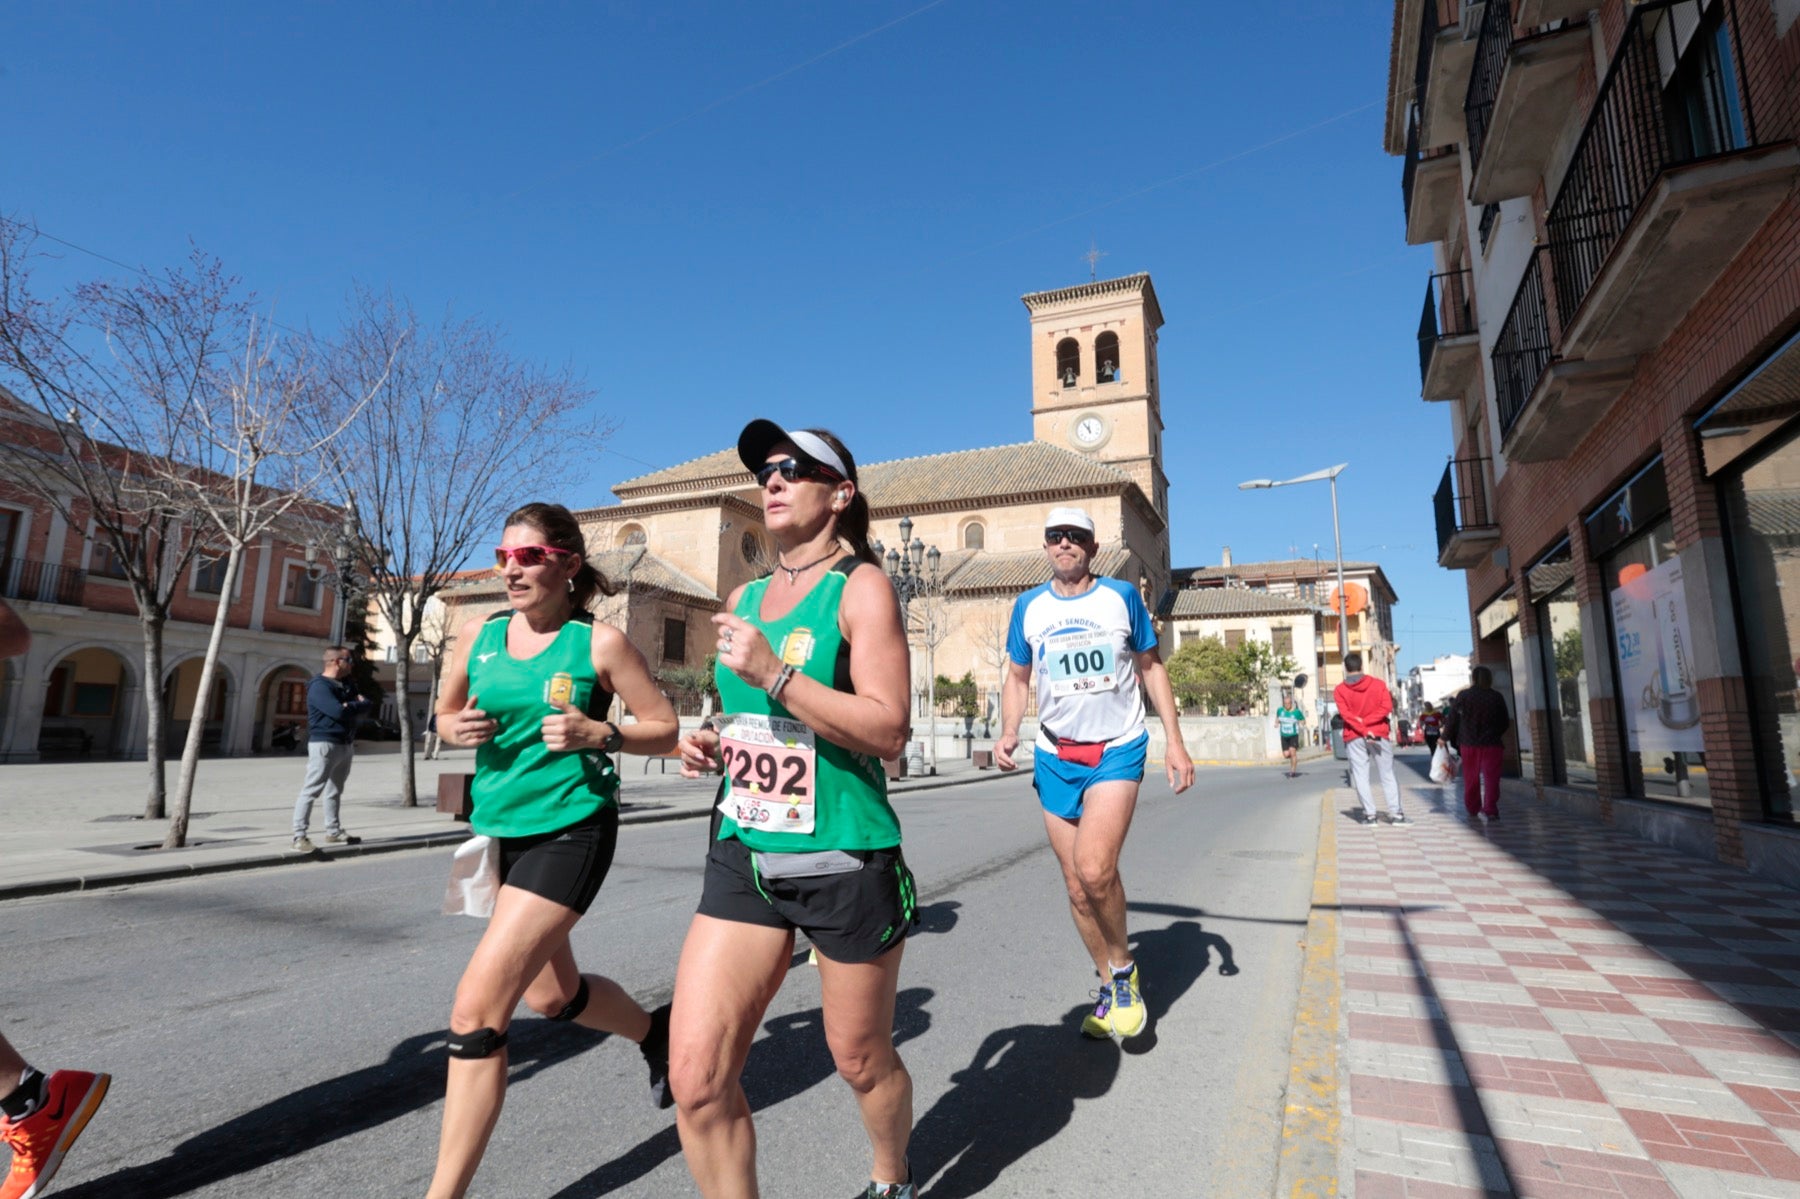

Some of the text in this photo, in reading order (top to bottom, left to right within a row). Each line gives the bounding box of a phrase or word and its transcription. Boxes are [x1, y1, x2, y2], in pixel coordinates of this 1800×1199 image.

[1059, 649, 1105, 675] 100
[772, 720, 781, 732] DE
[723, 745, 807, 796] 2292
